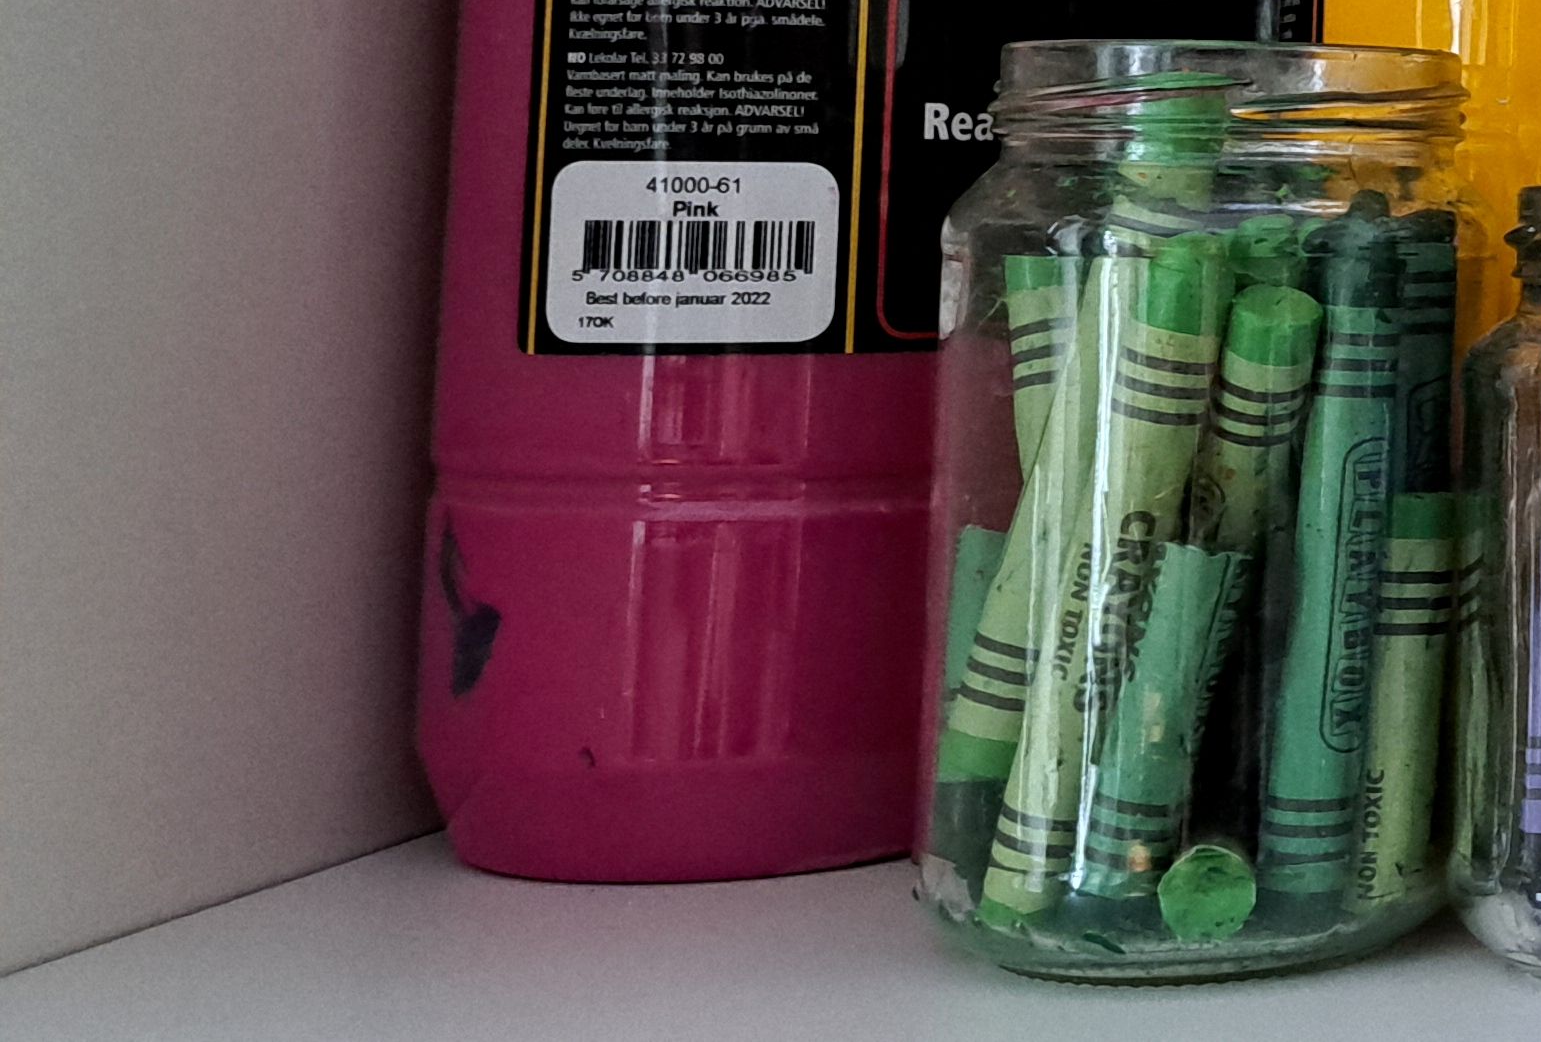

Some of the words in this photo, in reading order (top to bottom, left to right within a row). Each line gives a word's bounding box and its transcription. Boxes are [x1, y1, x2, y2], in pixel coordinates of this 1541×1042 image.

[676, 12, 709, 24] under
[714, 13, 721, 23] 3
[672, 53, 684, 64] 72
[708, 53, 724, 64] 00
[706, 71, 730, 82] Kan
[734, 71, 773, 83] brukes
[778, 71, 793, 85] på
[797, 71, 812, 83] de
[735, 105, 804, 117] ADVARSEL!
[690, 122, 697, 133] 3
[717, 121, 733, 135] på
[776, 125, 790, 134] av
[794, 123, 819, 134] små
[923, 102, 994, 141] Rea
[646, 177, 741, 194] 41000-61
[672, 201, 720, 218] Pink
[572, 270, 584, 282] 5
[600, 270, 685, 282] 708848
[703, 270, 797, 282] 066985
[586, 291, 618, 305] Best
[623, 291, 671, 305] before
[676, 292, 726, 308] januar
[731, 292, 771, 305] 2022
[1051, 610, 1083, 681] TOXIC
[1361, 767, 1385, 847] TOXIC
